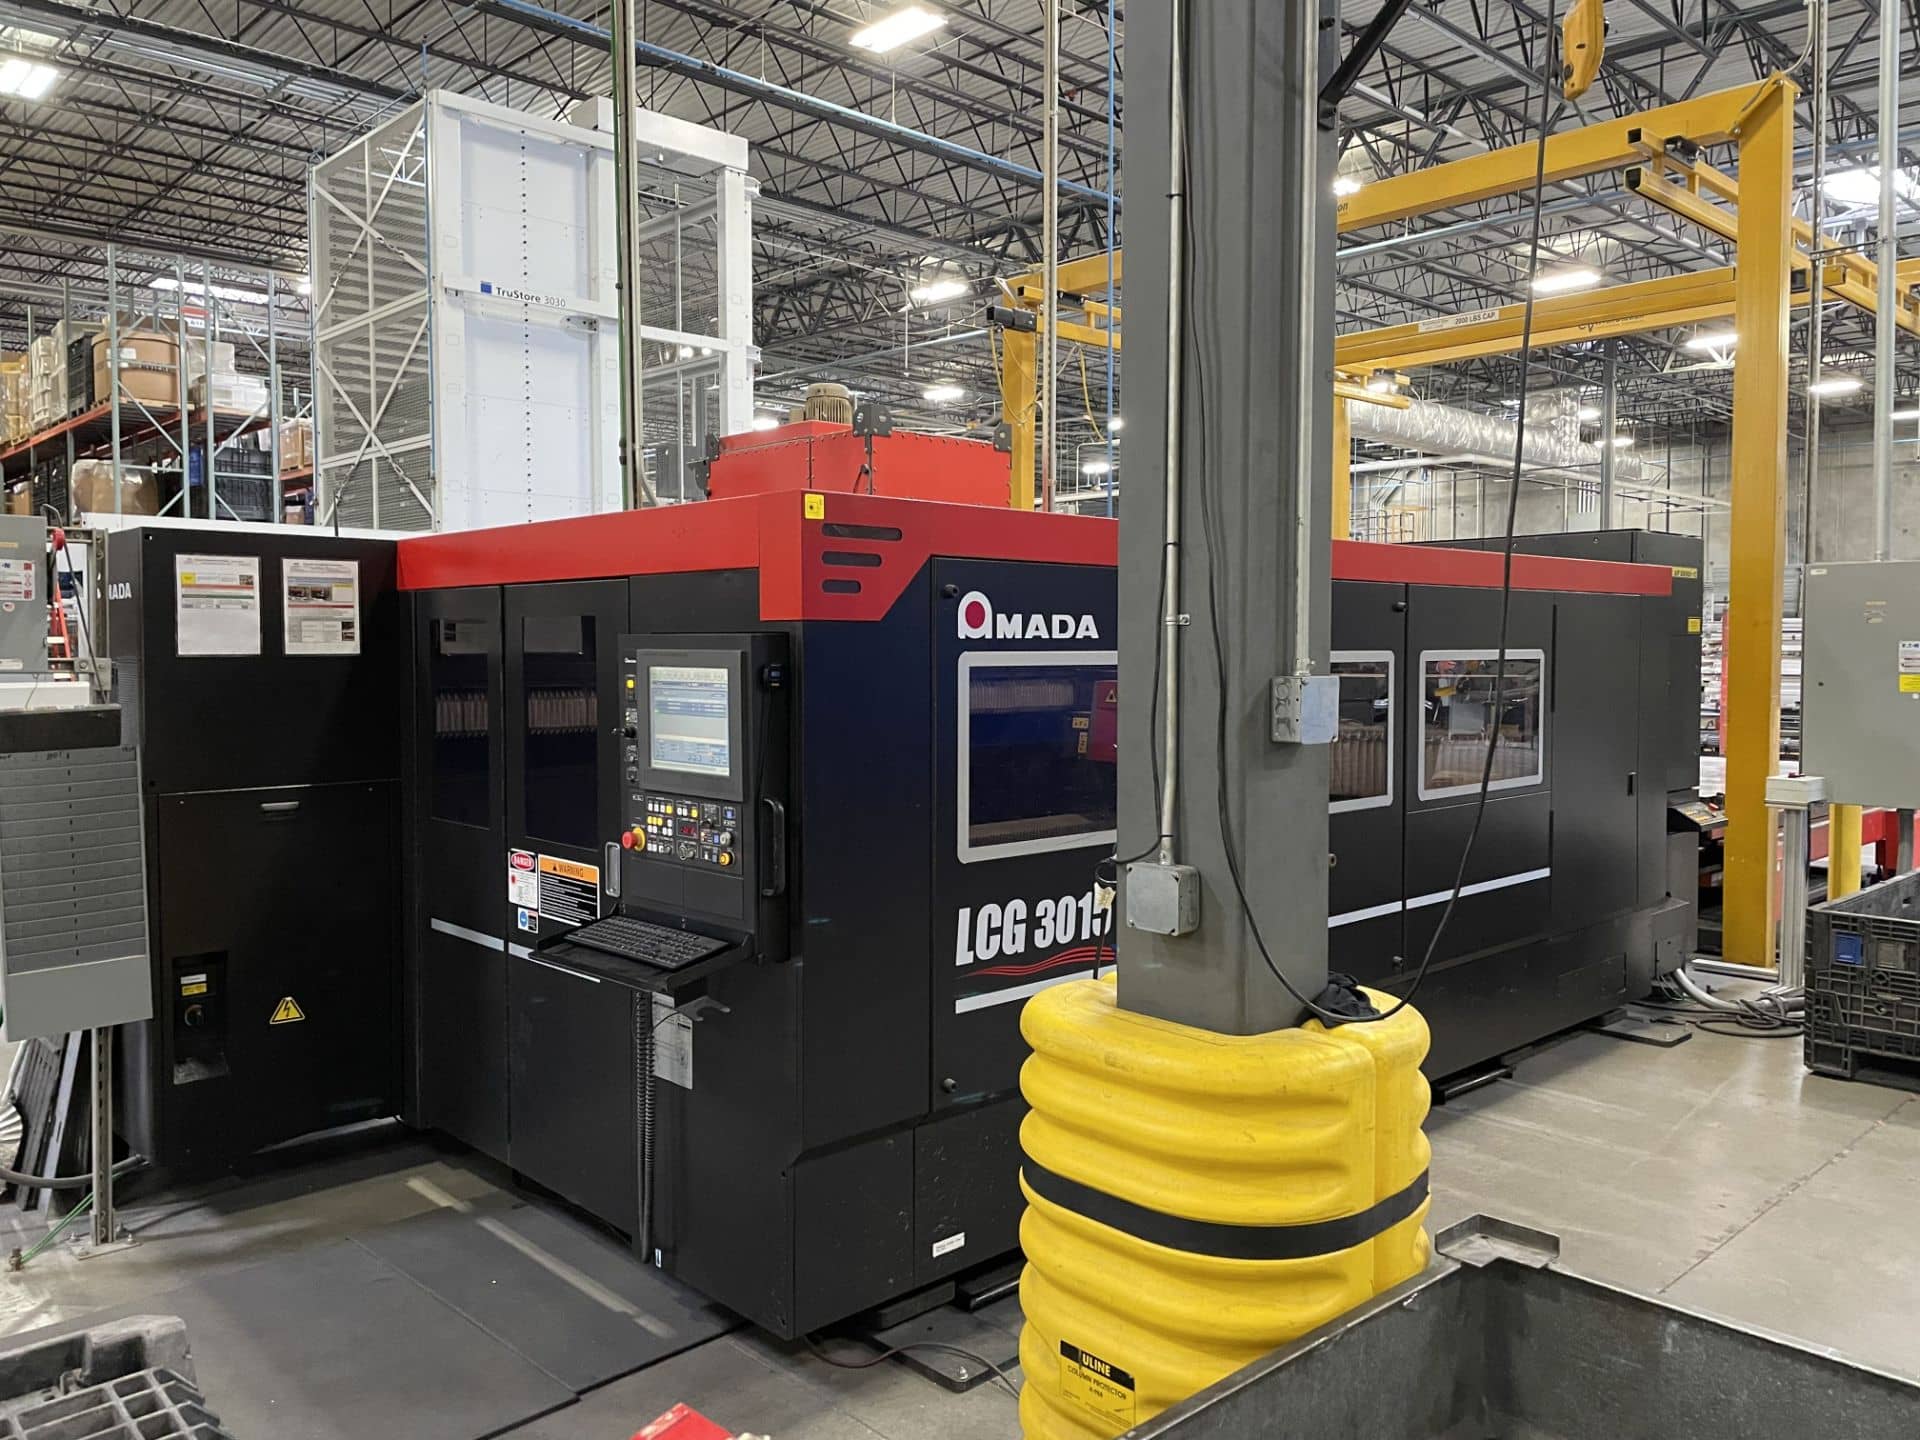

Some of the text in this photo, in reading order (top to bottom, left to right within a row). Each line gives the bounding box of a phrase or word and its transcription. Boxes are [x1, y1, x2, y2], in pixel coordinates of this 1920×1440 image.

[496, 286, 566, 307] TruStore 3030
[957, 590, 1100, 639] AMADA
[559, 865, 584, 878] WARNING
[955, 890, 1112, 966] LCG 3015
[1082, 1352, 1112, 1378] ULINE
